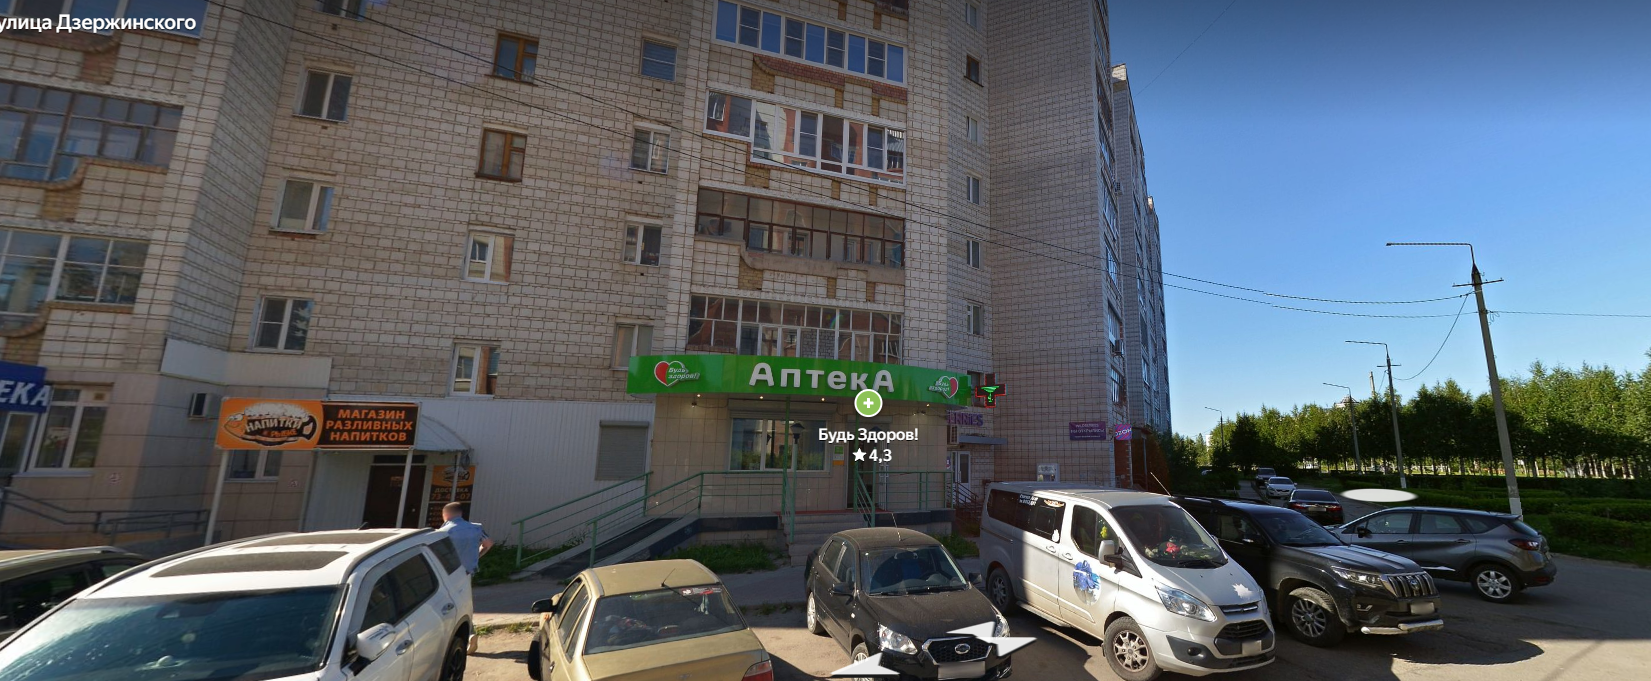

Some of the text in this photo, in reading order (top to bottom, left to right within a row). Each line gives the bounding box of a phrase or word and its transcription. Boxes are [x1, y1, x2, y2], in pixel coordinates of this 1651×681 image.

[338, 408, 406, 420] МАГАЗИН
[245, 418, 303, 432] НАПИТКИ
[326, 420, 413, 431] РАЗЛИВНЫХ
[330, 431, 407, 442] НАПИТКОВ
